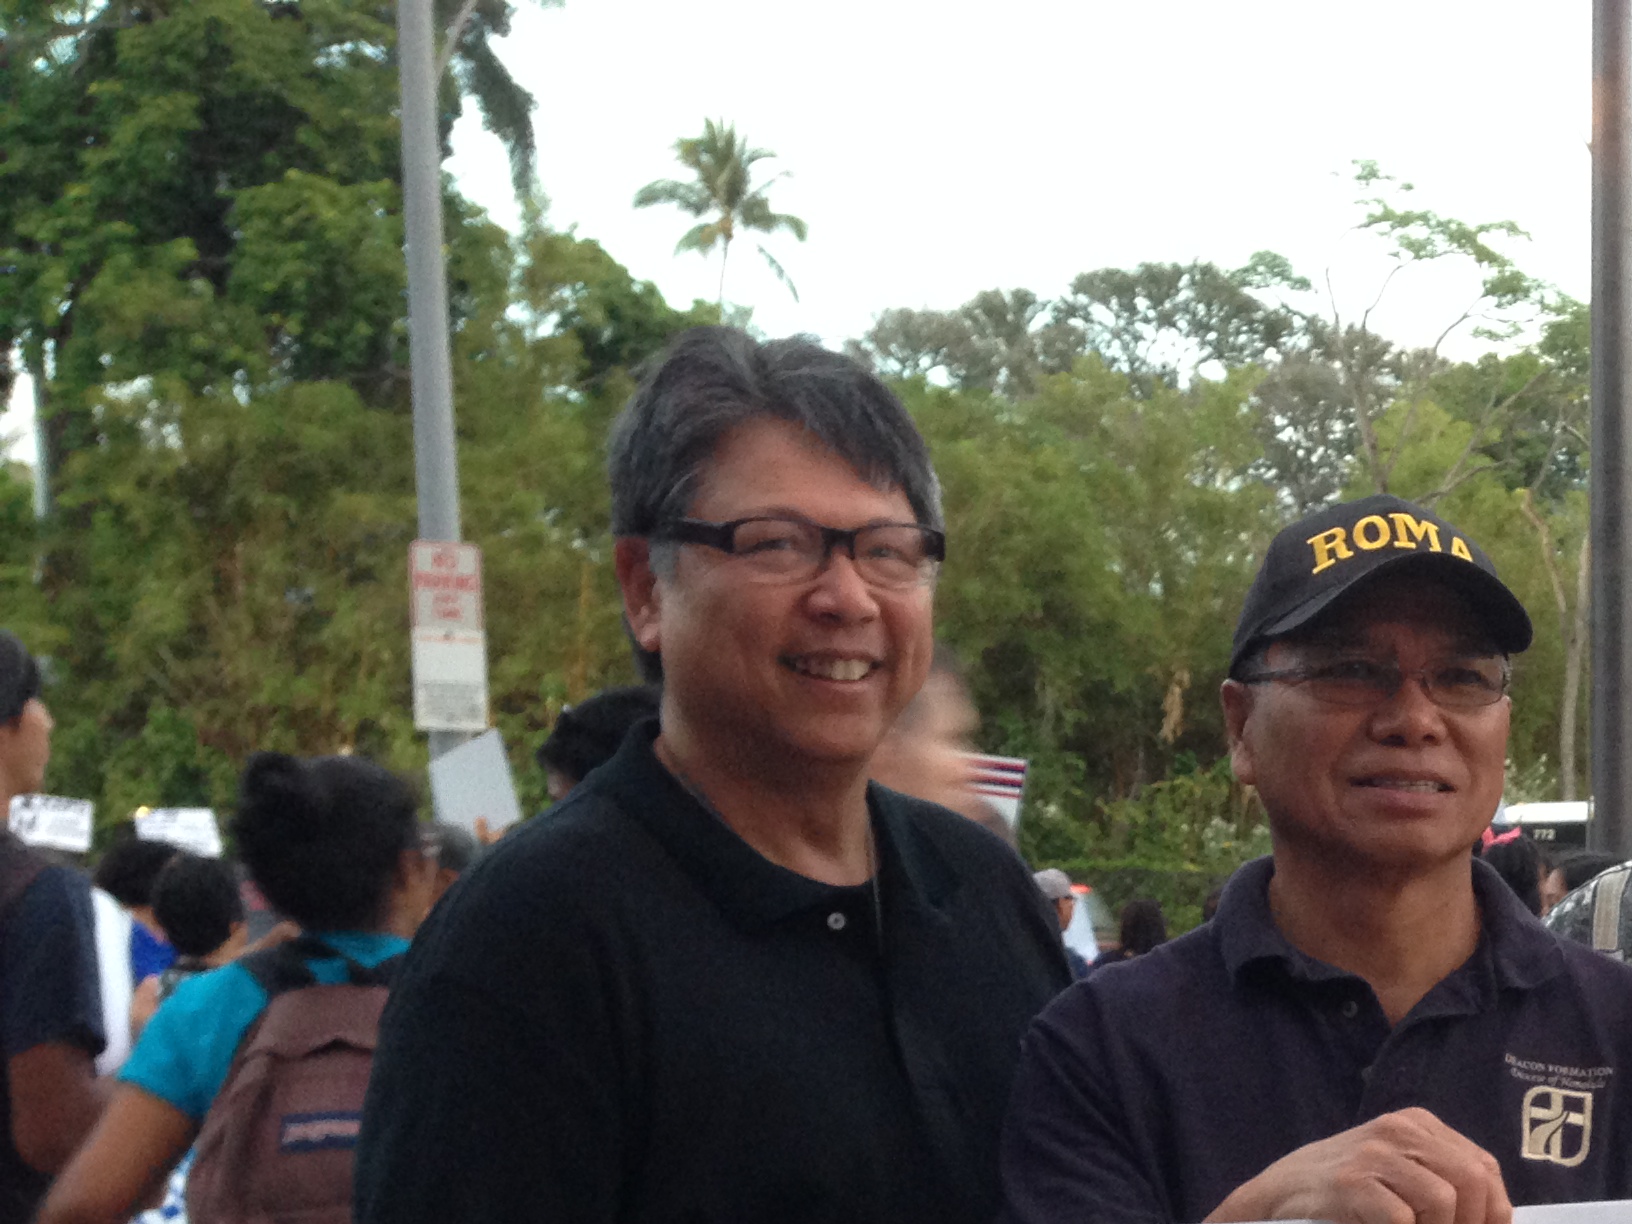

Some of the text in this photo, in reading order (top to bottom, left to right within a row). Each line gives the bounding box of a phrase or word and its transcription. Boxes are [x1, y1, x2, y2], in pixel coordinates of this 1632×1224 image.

[1306, 512, 1474, 575] ROMA
[1533, 828, 1556, 840] 772
[1504, 1052, 1614, 1077] DEACON FORMATION
